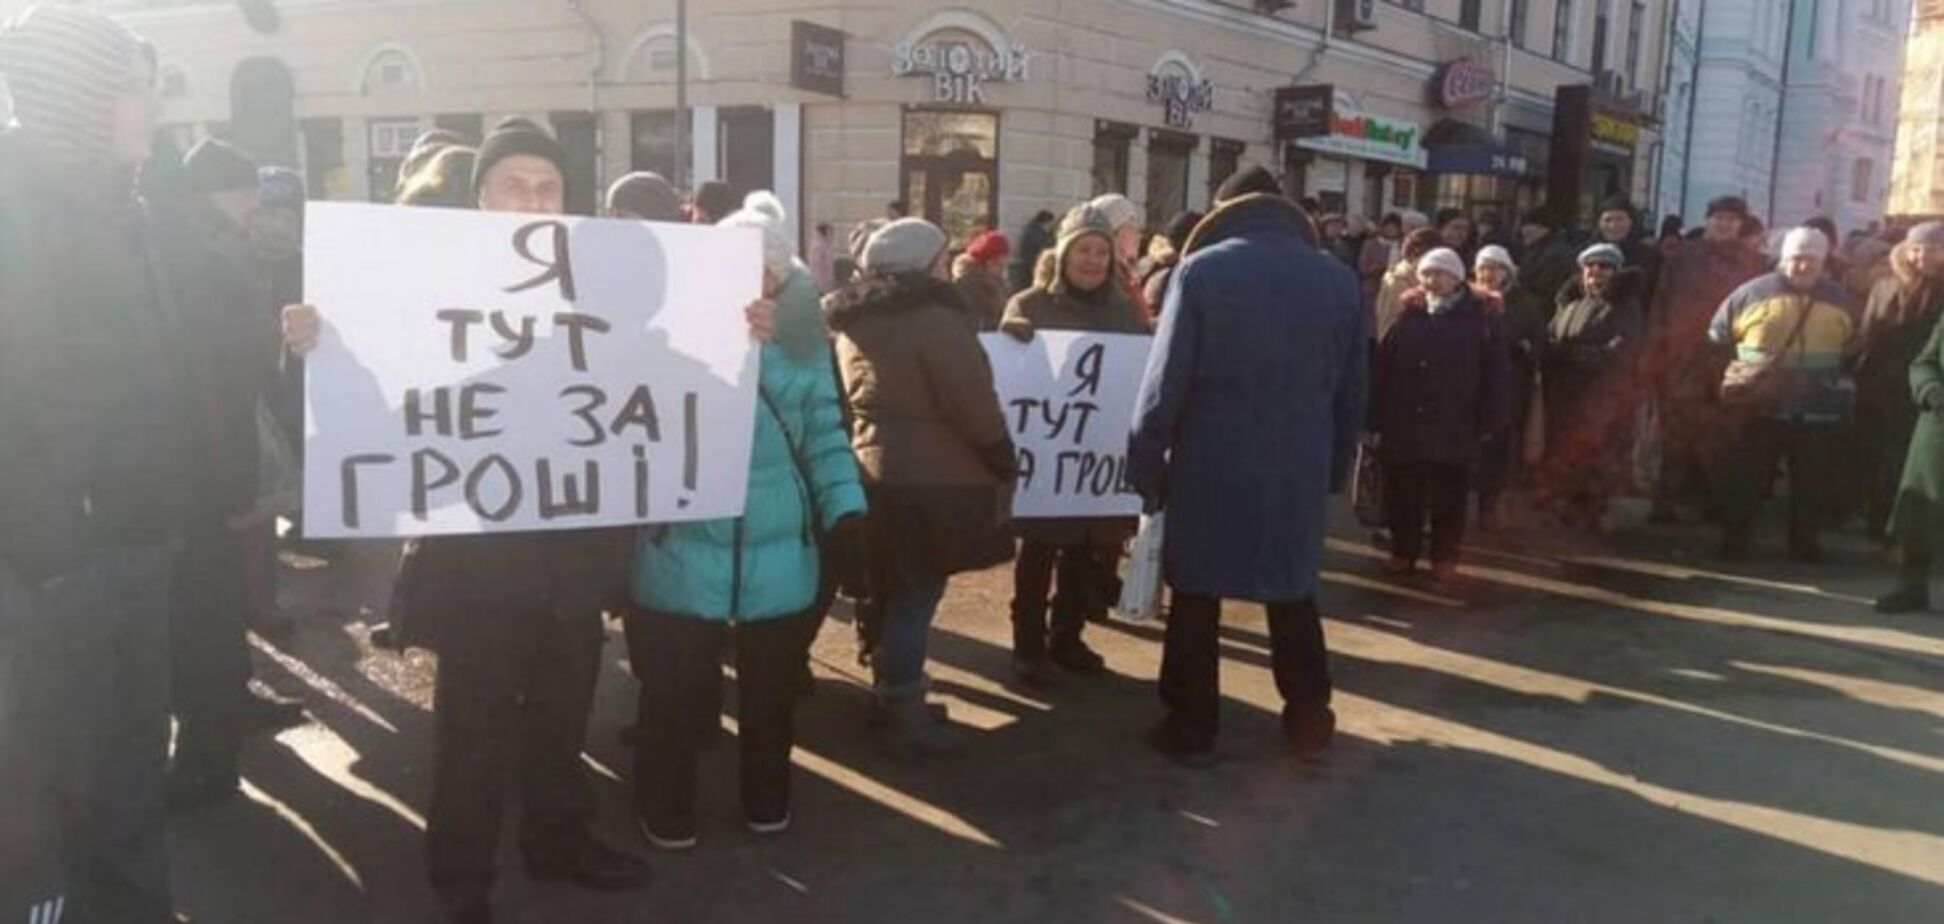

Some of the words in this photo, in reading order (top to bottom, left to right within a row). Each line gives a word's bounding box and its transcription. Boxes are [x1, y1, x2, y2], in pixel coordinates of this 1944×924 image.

[501, 220, 577, 302] Я
[436, 309, 611, 372] ТУТ
[1067, 342, 1105, 397] Я
[403, 383, 507, 440] НЕ
[558, 384, 661, 447] ЗА
[1009, 397, 1100, 445] ТУТ
